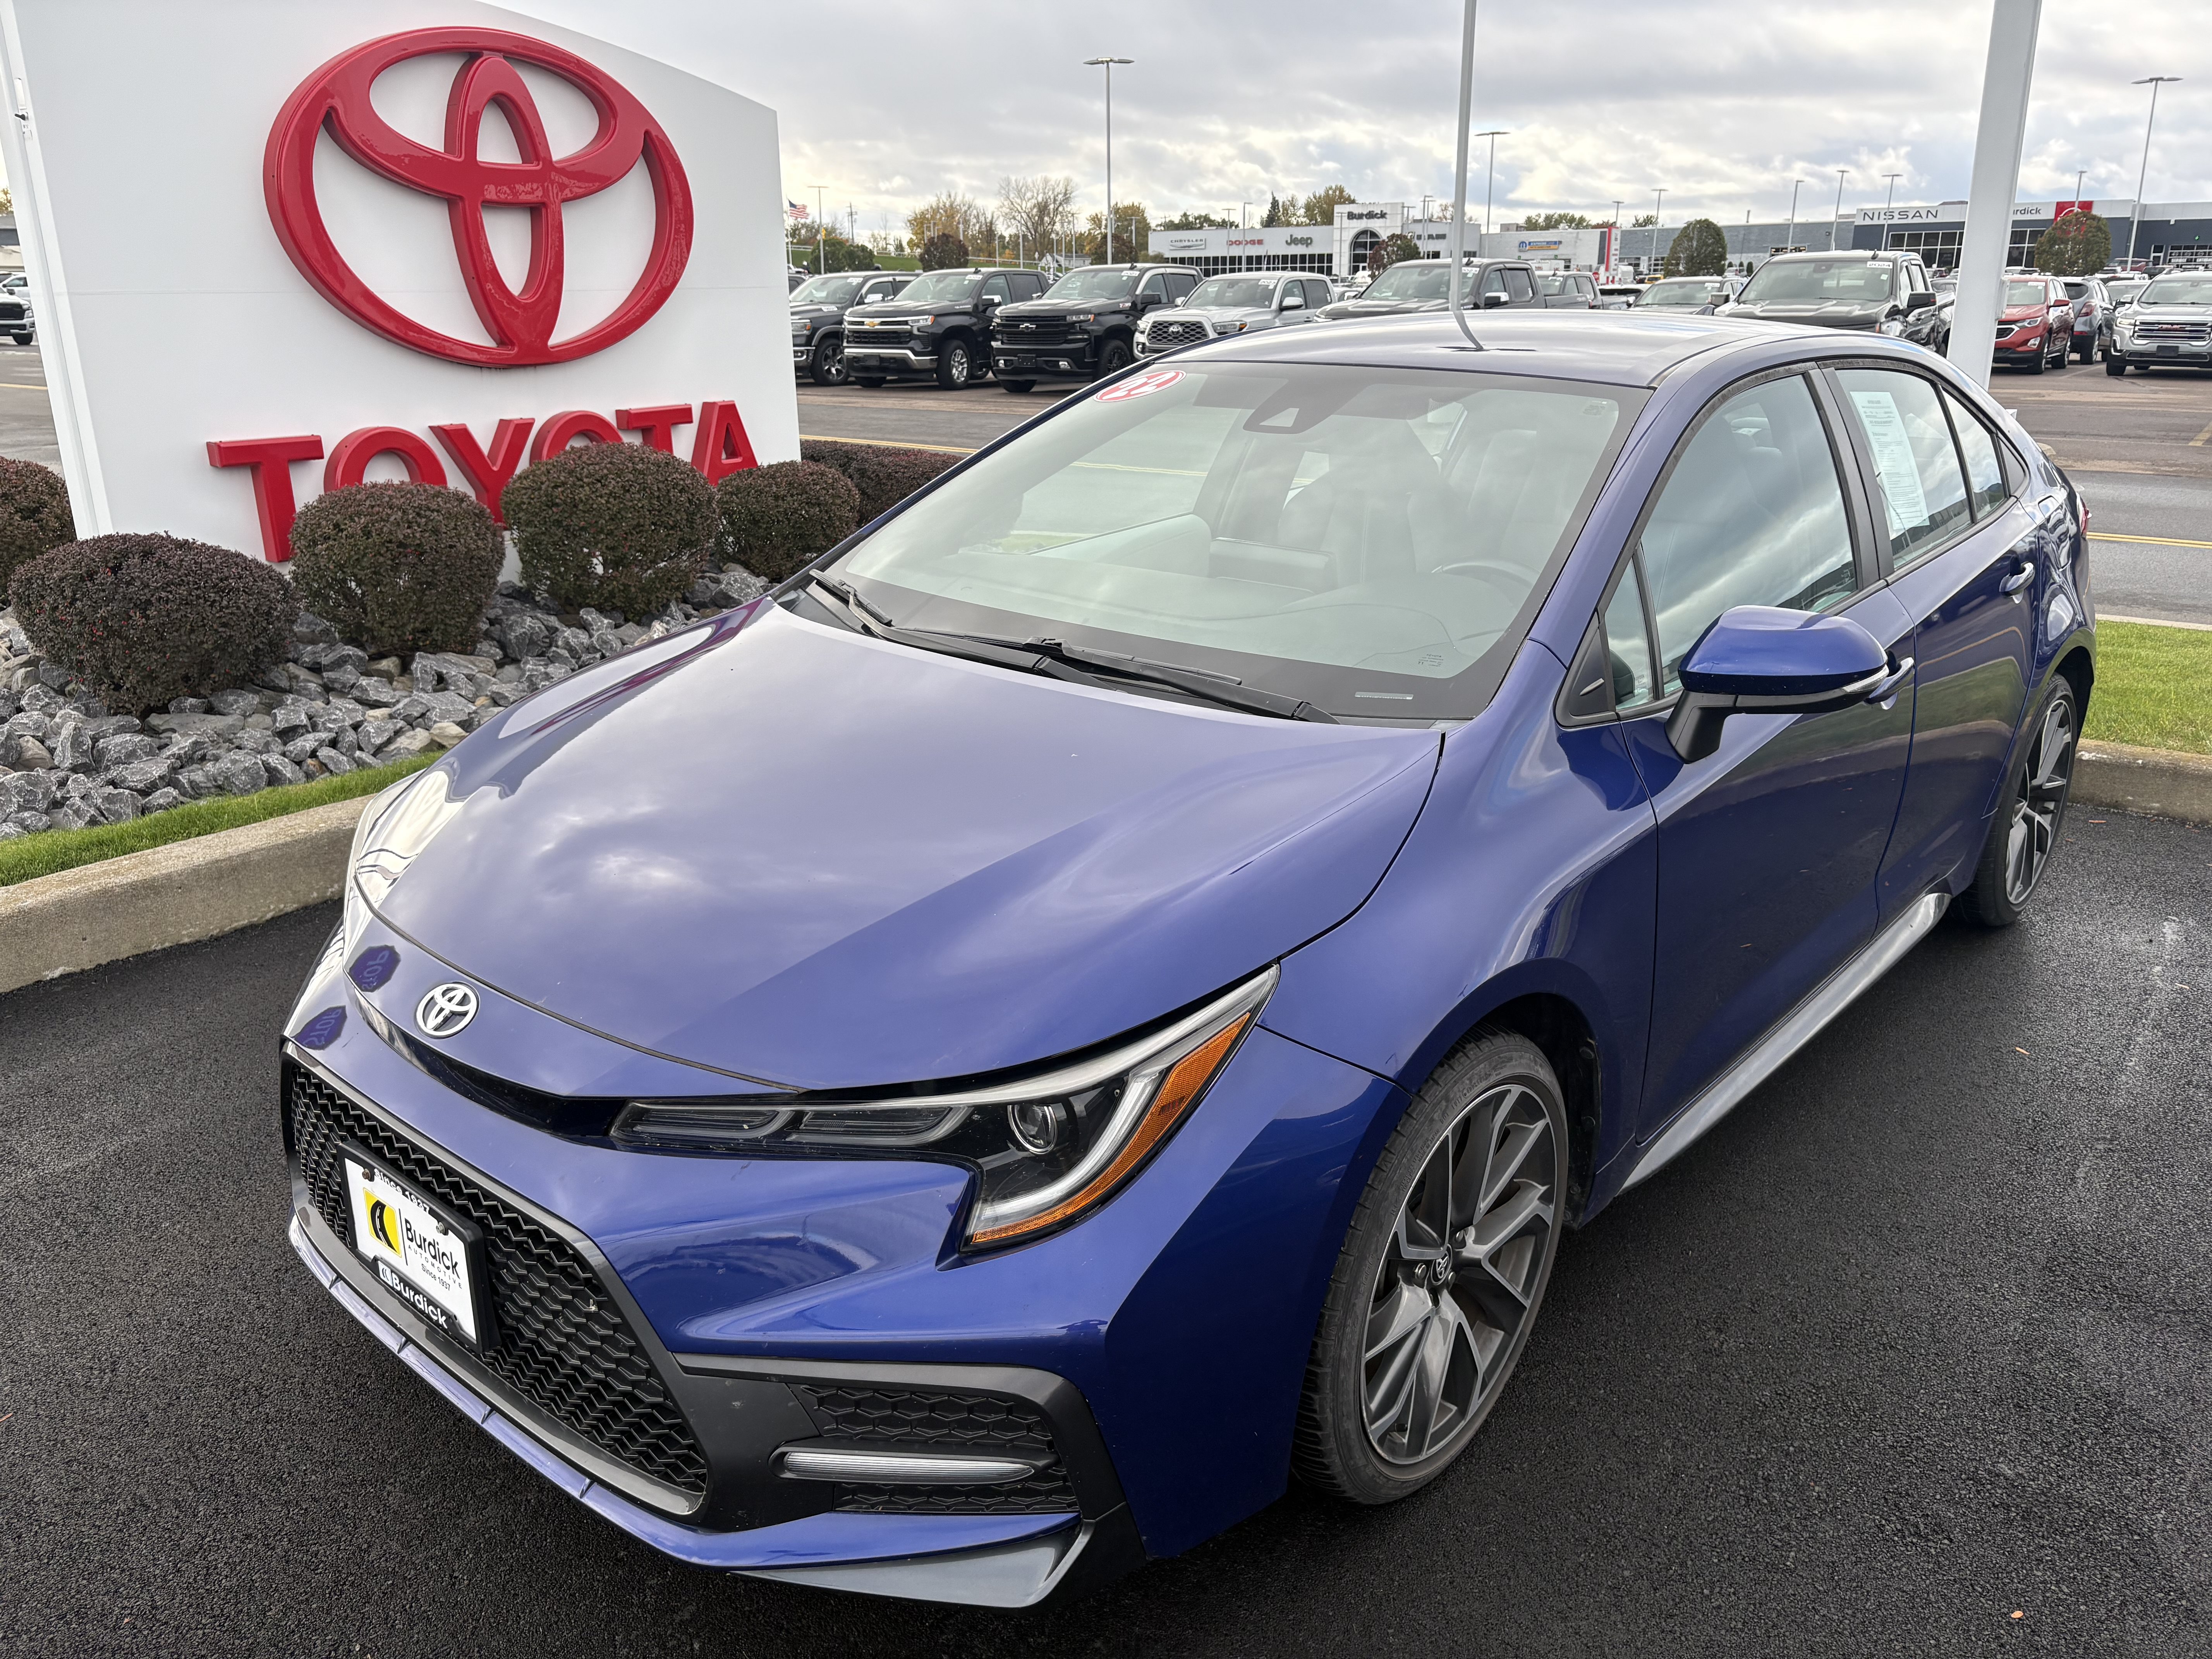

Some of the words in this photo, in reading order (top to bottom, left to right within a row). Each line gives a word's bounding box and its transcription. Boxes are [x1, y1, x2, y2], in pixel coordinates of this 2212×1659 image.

[1347, 210, 1388, 220] Burdick
[1863, 210, 1938, 221] NISSAN
[1285, 234, 1313, 248] Jeep
[374, 1168, 403, 1195] Since
[405, 1191, 430, 1214] 1937
[404, 1217, 460, 1279] Burdick
[409, 1244, 462, 1289] AUTOMOTIVE
[421, 1263, 436, 1281] Since
[438, 1277, 450, 1291] 1937
[392, 1272, 448, 1329] Burdick
